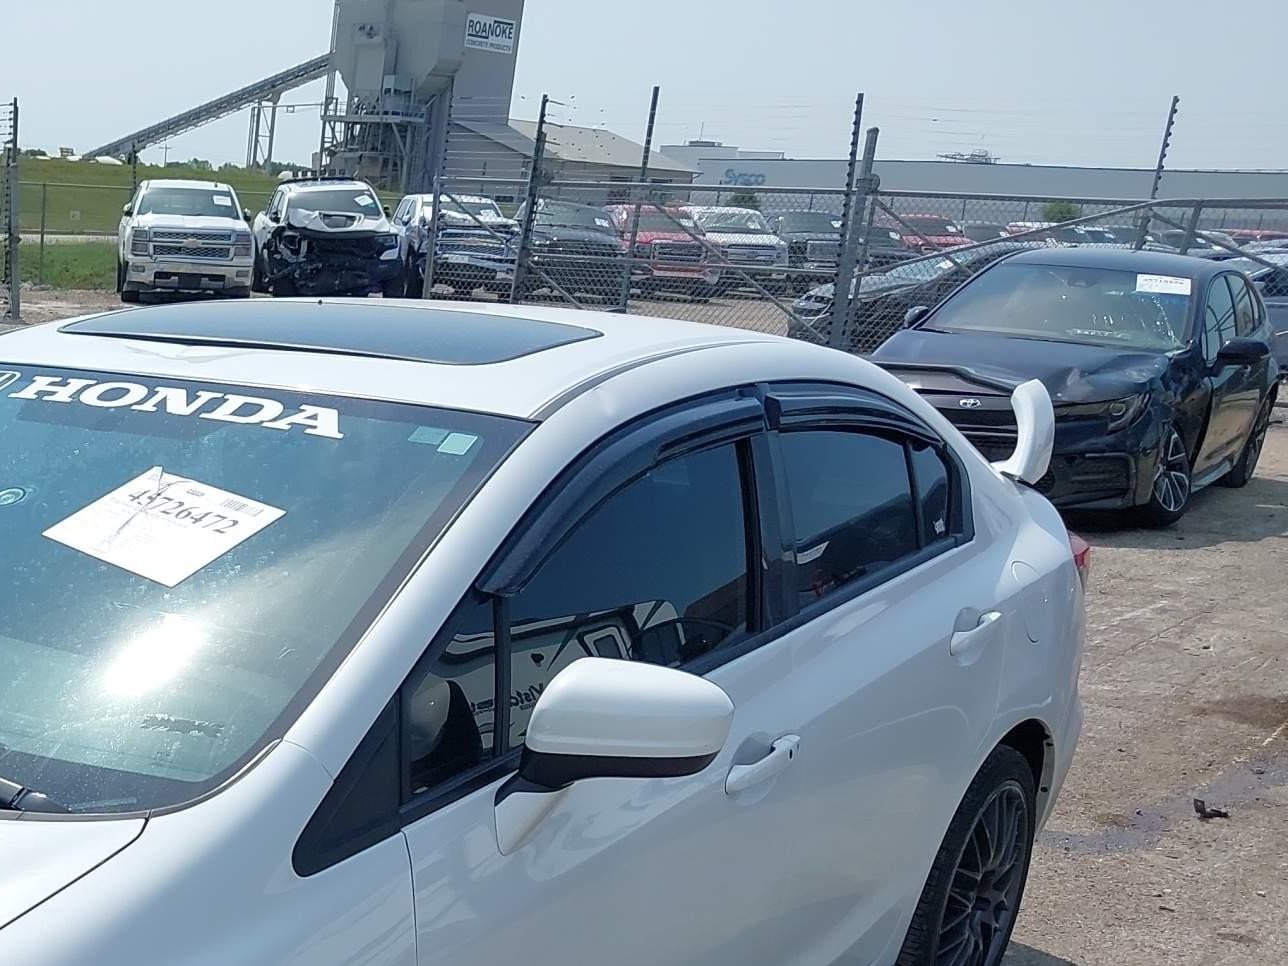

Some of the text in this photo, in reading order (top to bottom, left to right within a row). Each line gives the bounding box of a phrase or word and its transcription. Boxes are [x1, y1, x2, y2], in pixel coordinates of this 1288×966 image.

[467, 19, 514, 40] ROANOKE
[724, 168, 766, 186] Sysco
[8, 375, 344, 440] HONDA
